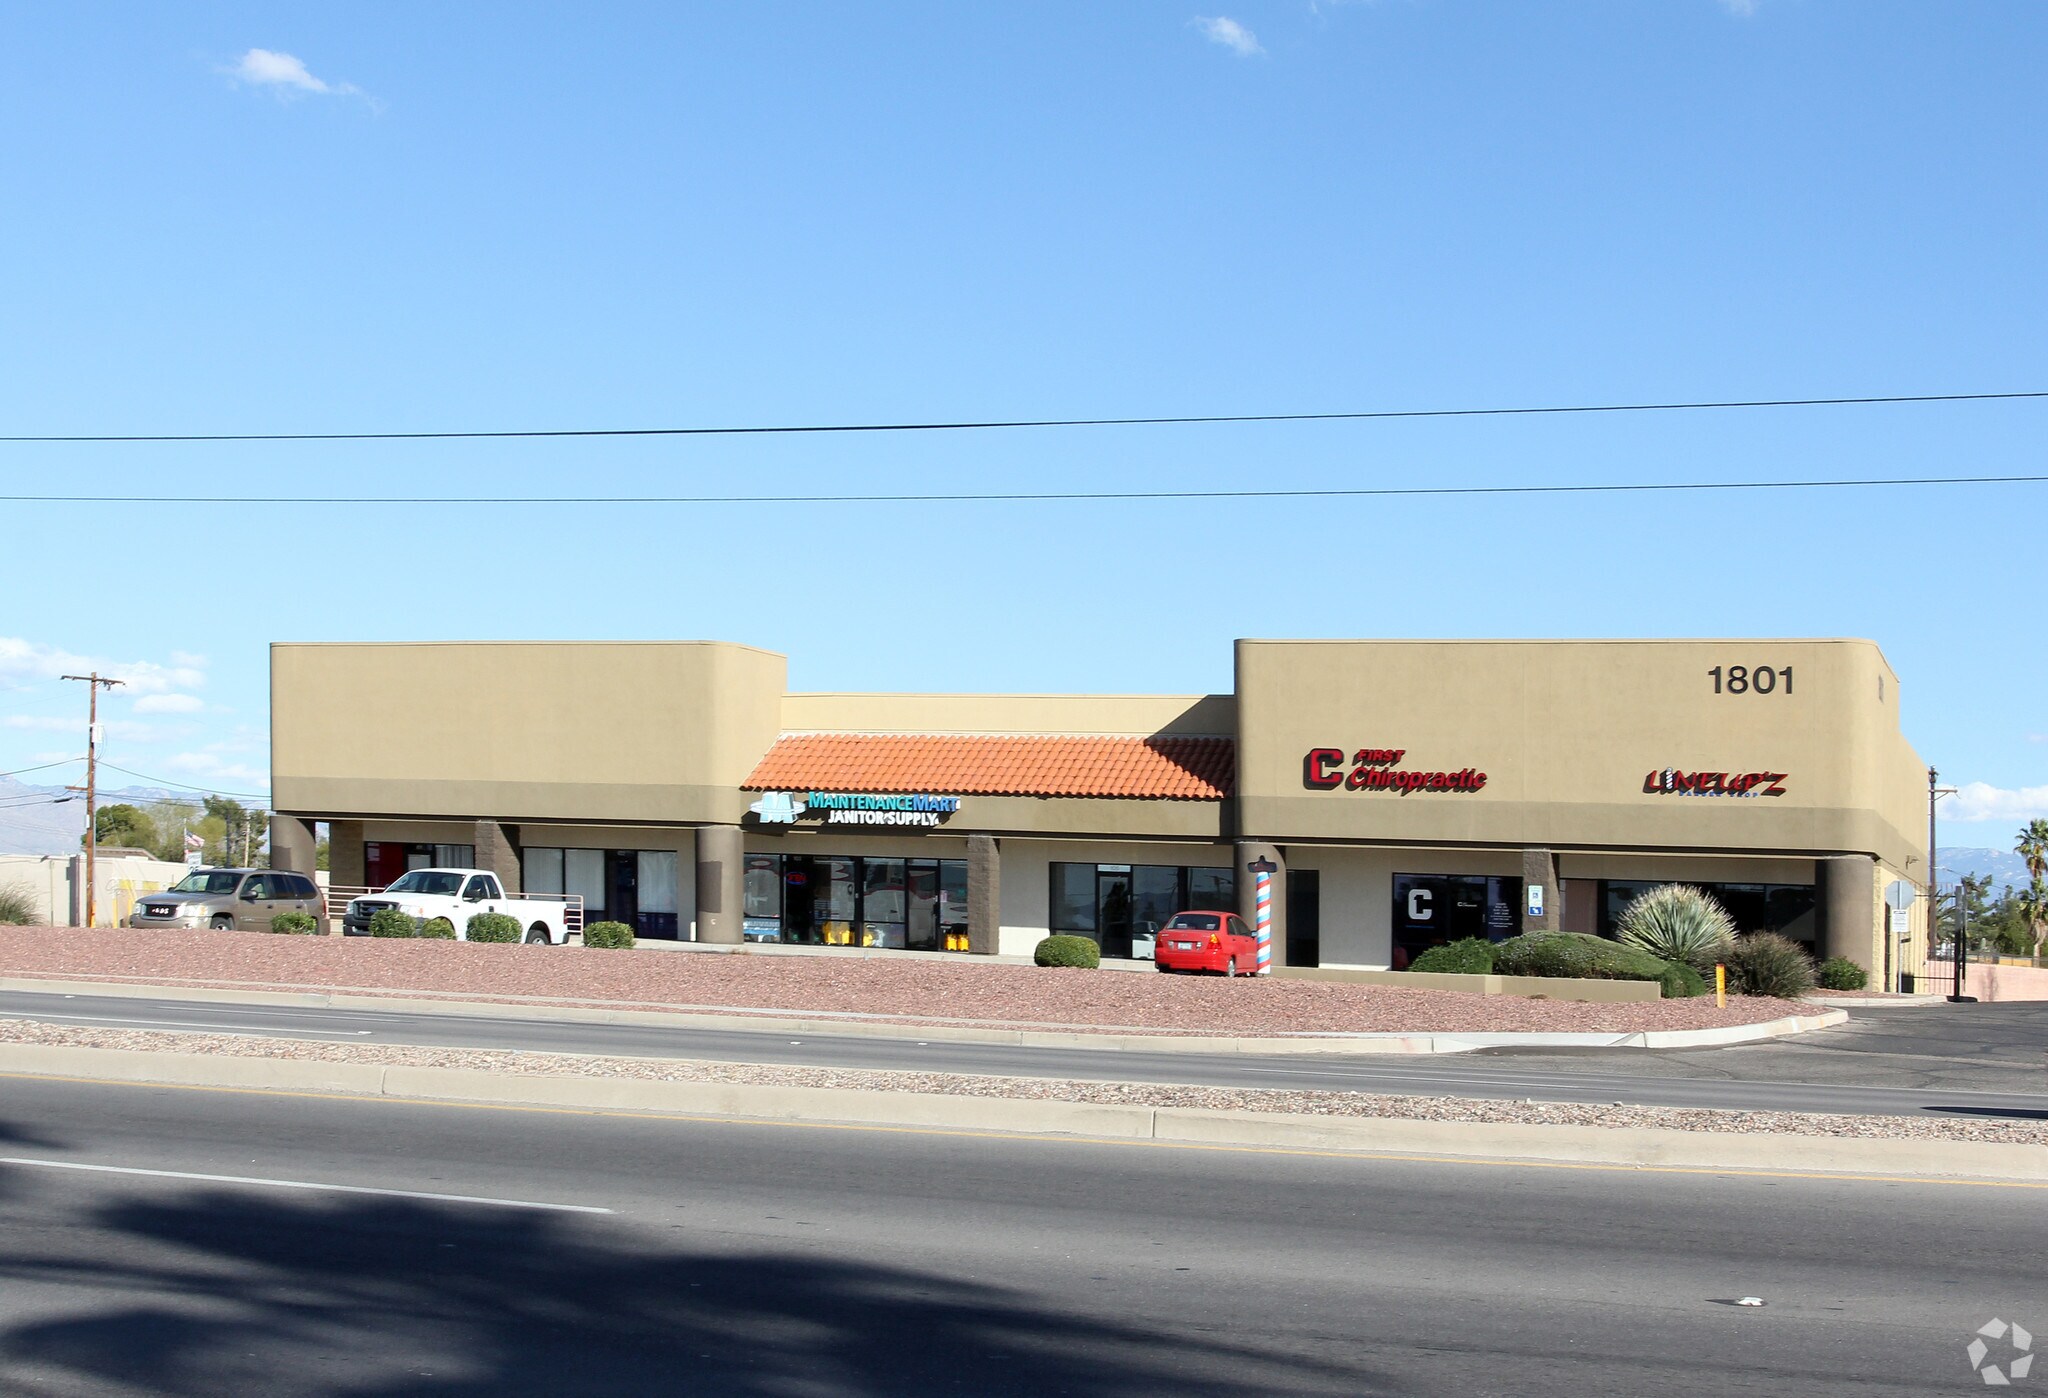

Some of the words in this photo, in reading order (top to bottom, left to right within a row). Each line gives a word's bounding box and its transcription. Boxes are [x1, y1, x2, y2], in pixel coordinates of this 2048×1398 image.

[1707, 666, 1793, 694] 1801
[1305, 748, 1344, 788] C
[1355, 749, 1406, 763] FIRST
[1348, 766, 1488, 794] Chiropractic
[828, 810, 885, 825] JANITOR
[886, 811, 938, 827] SUPPLY
[1408, 889, 1433, 920] C
